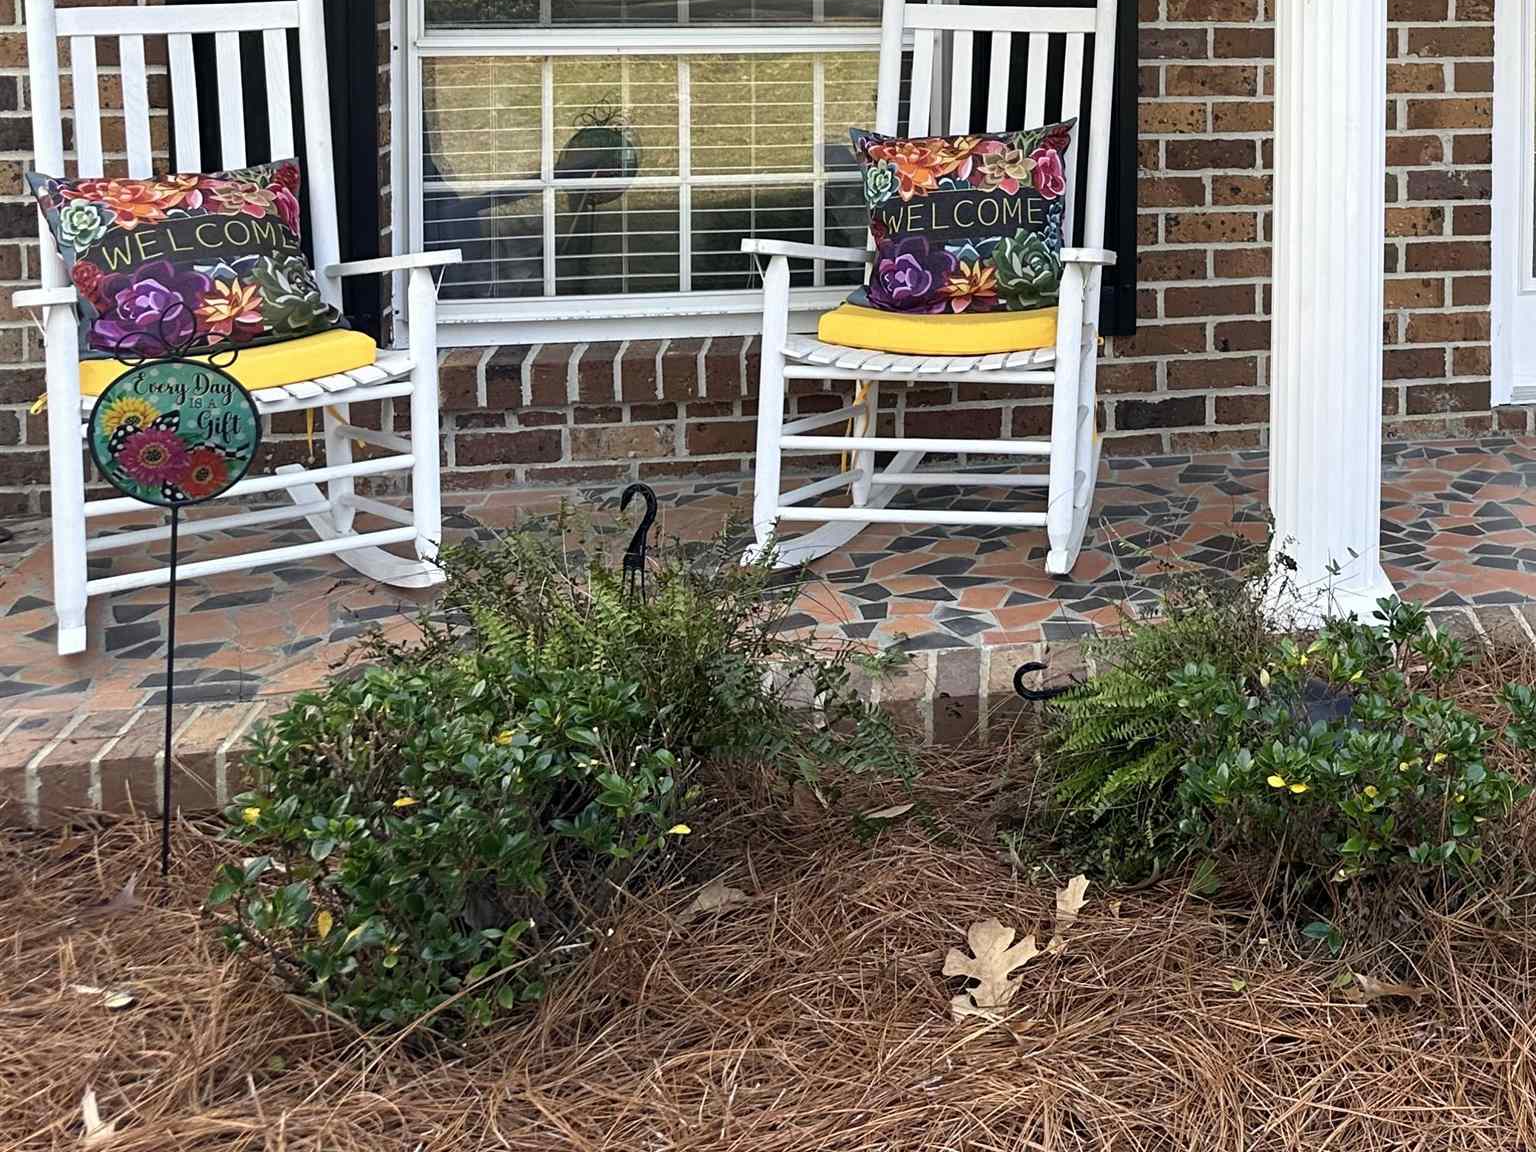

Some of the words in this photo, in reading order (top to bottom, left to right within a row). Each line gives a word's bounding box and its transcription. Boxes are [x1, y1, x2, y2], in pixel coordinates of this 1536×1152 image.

[882, 197, 1044, 235] WELCOME
[134, 372, 187, 405] Every
[192, 372, 233, 405] Day
[197, 410, 241, 443] Gift
